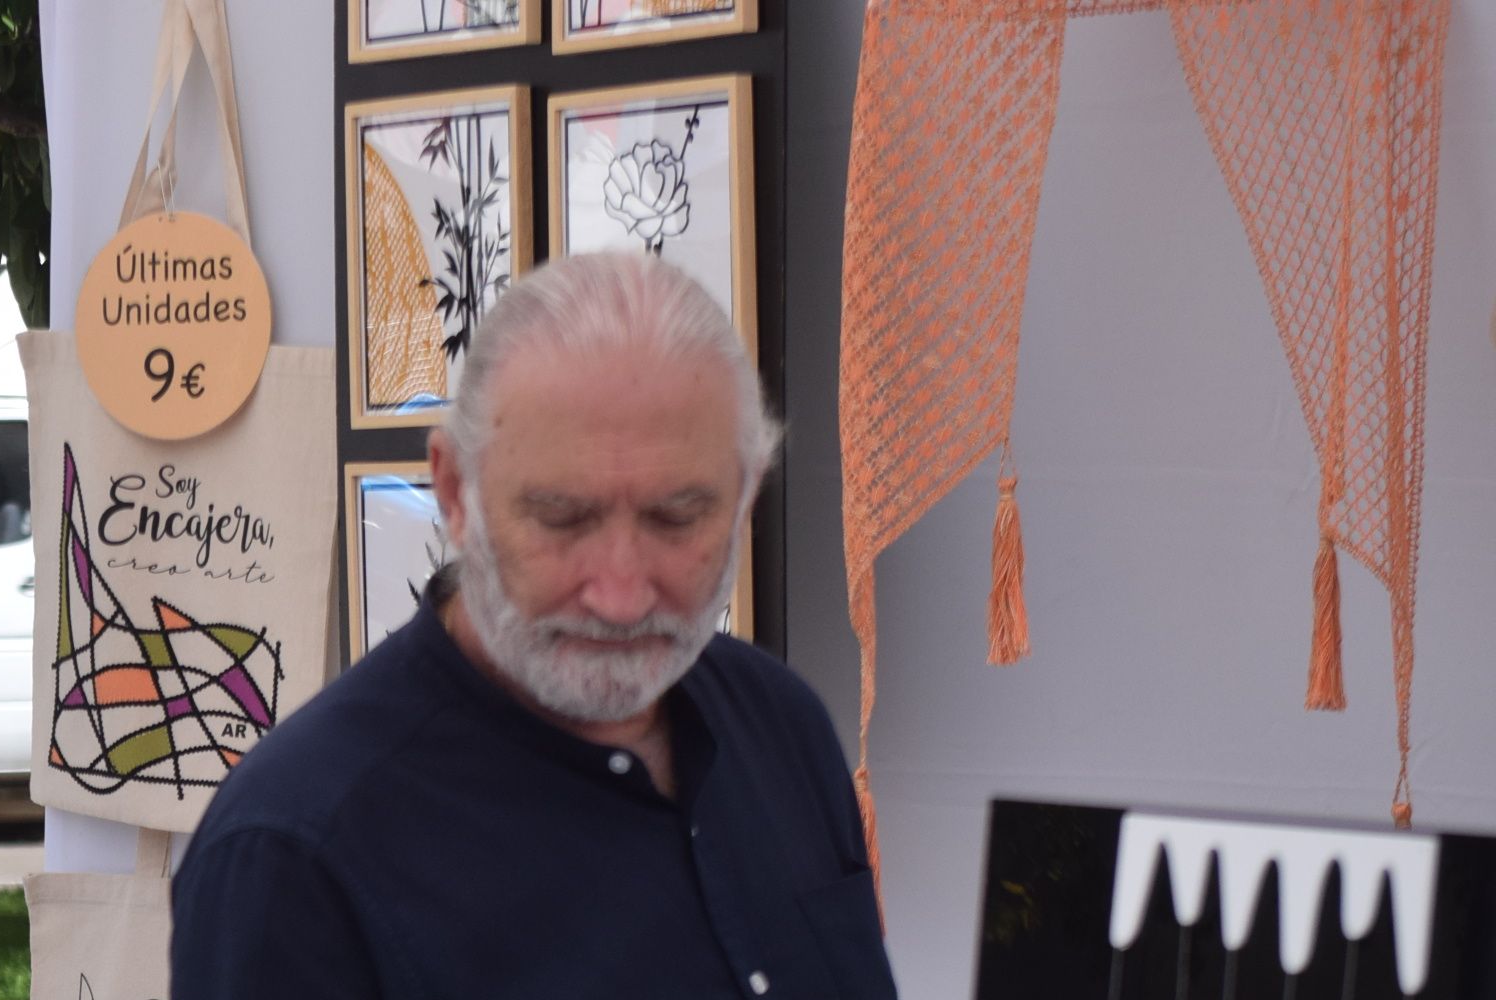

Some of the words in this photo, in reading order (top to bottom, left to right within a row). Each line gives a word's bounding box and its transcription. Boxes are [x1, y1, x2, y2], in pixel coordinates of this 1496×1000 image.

[116, 244, 233, 283] Últimas
[102, 292, 247, 326] Unidades
[143, 347, 206, 403] 9€
[154, 464, 202, 509] Soy
[97, 474, 275, 568] Encajera,
[106, 557, 192, 576] creo
[203, 560, 276, 584] arte
[221, 722, 247, 739] AR
